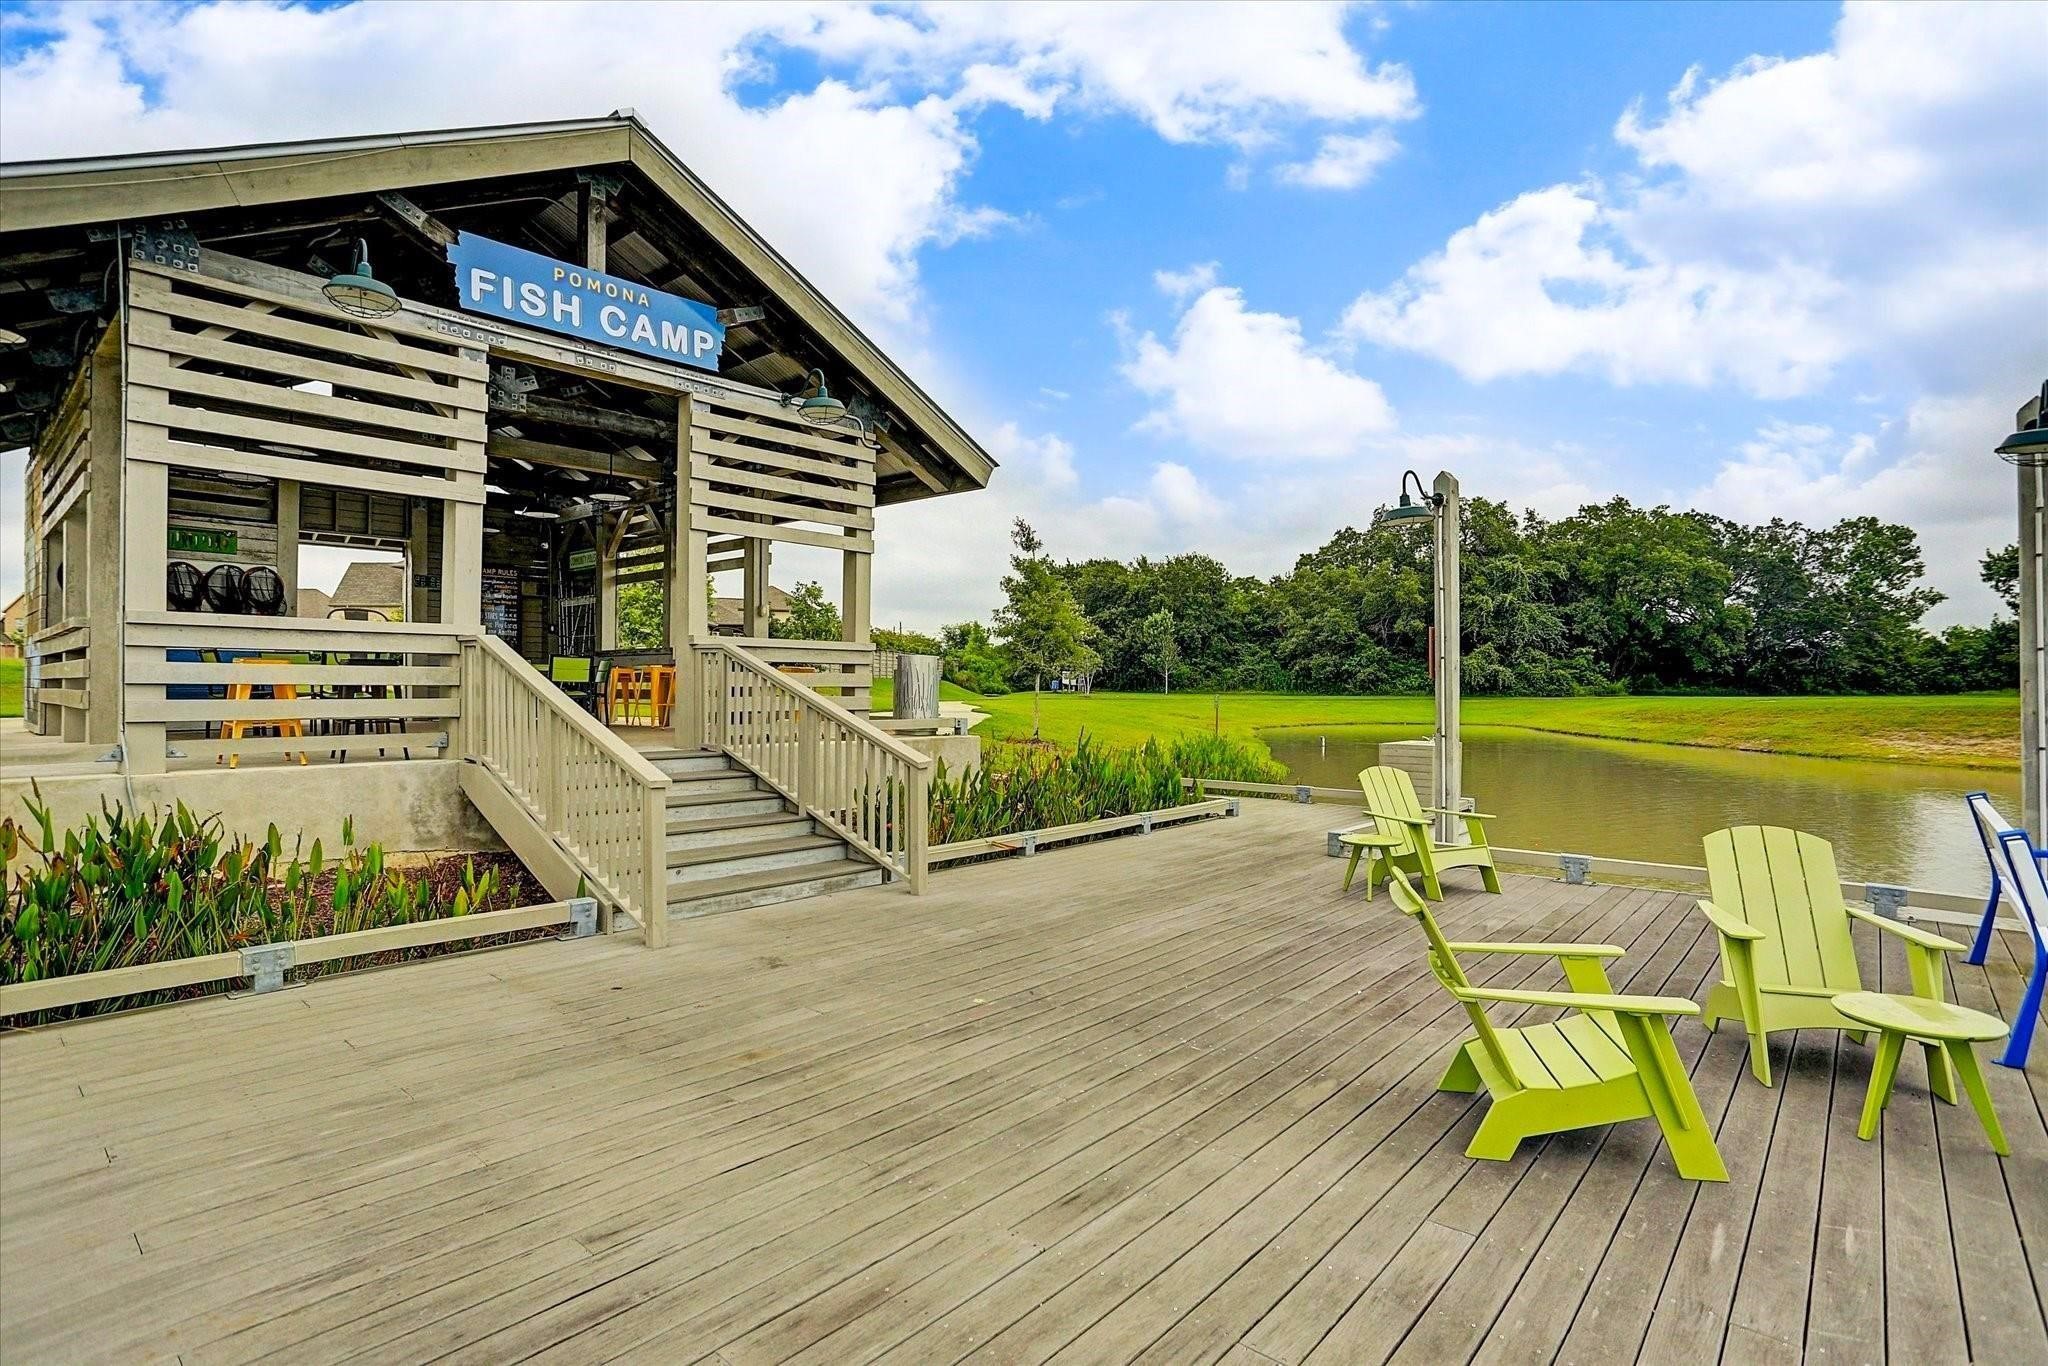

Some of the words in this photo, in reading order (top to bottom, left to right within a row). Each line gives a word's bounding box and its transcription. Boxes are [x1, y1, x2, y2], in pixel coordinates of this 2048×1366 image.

[553, 267, 650, 307] POMONA
[470, 267, 582, 328] FISH
[599, 305, 714, 358] CAMP
[497, 568, 518, 577] RULES
